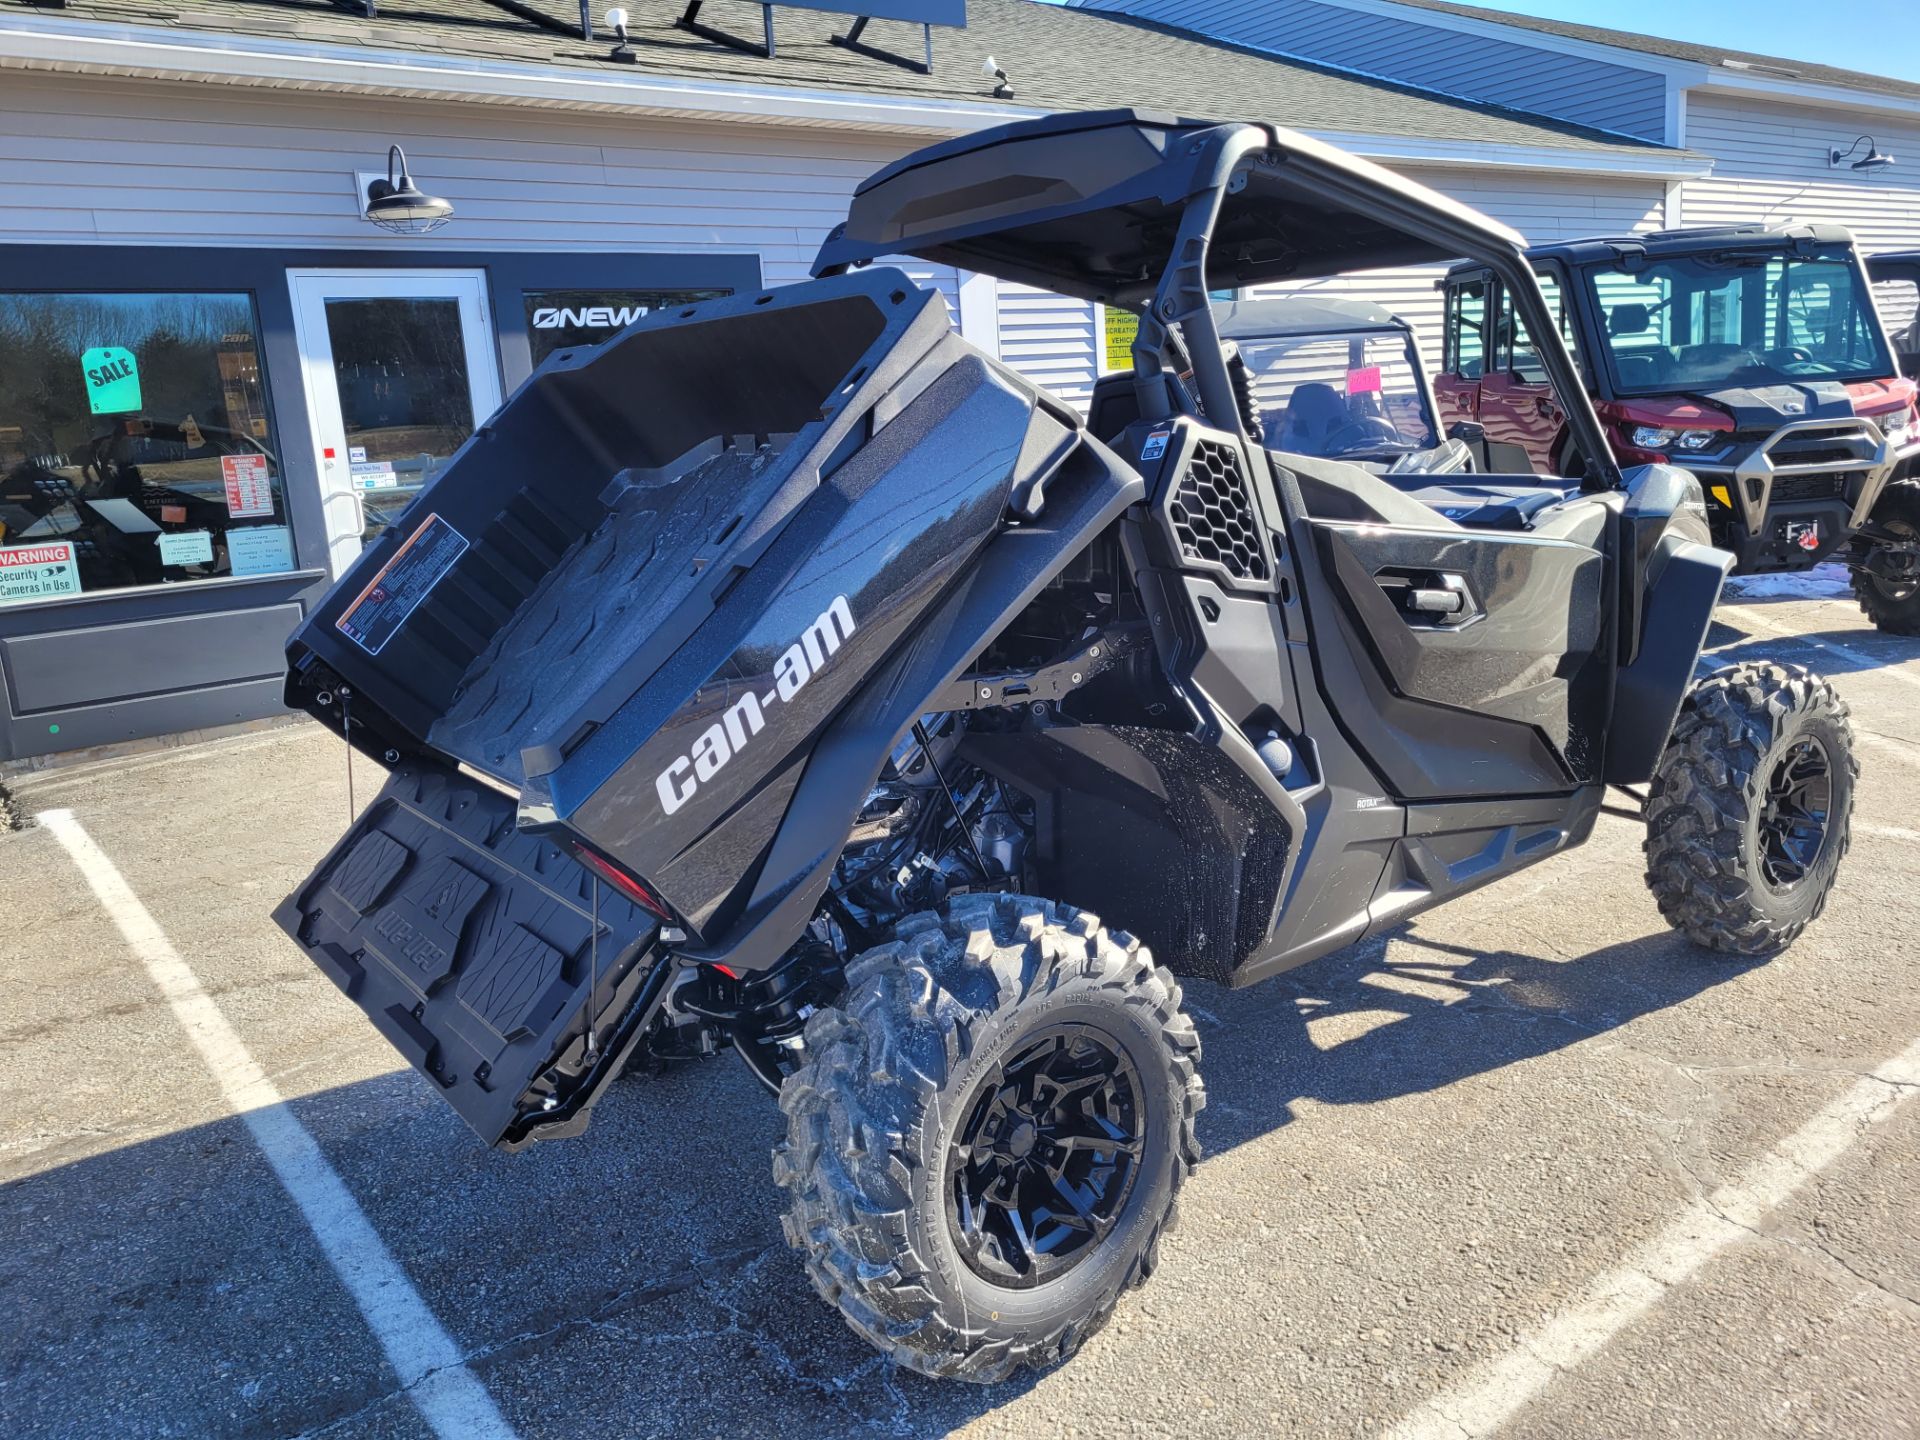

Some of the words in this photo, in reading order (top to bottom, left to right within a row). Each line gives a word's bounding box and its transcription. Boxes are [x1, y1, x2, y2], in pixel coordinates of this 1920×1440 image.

[533, 306, 650, 328] ONEW
[87, 358, 134, 387] SALE
[0, 548, 67, 565] WARNING
[0, 567, 38, 582] Security
[0, 583, 40, 596] Cameras
[42, 581, 52, 592] In
[53, 579, 71, 590] Use
[655, 594, 857, 816] can-am
[925, 1127, 945, 1201] KING
[926, 1208, 951, 1286] TRAIL
